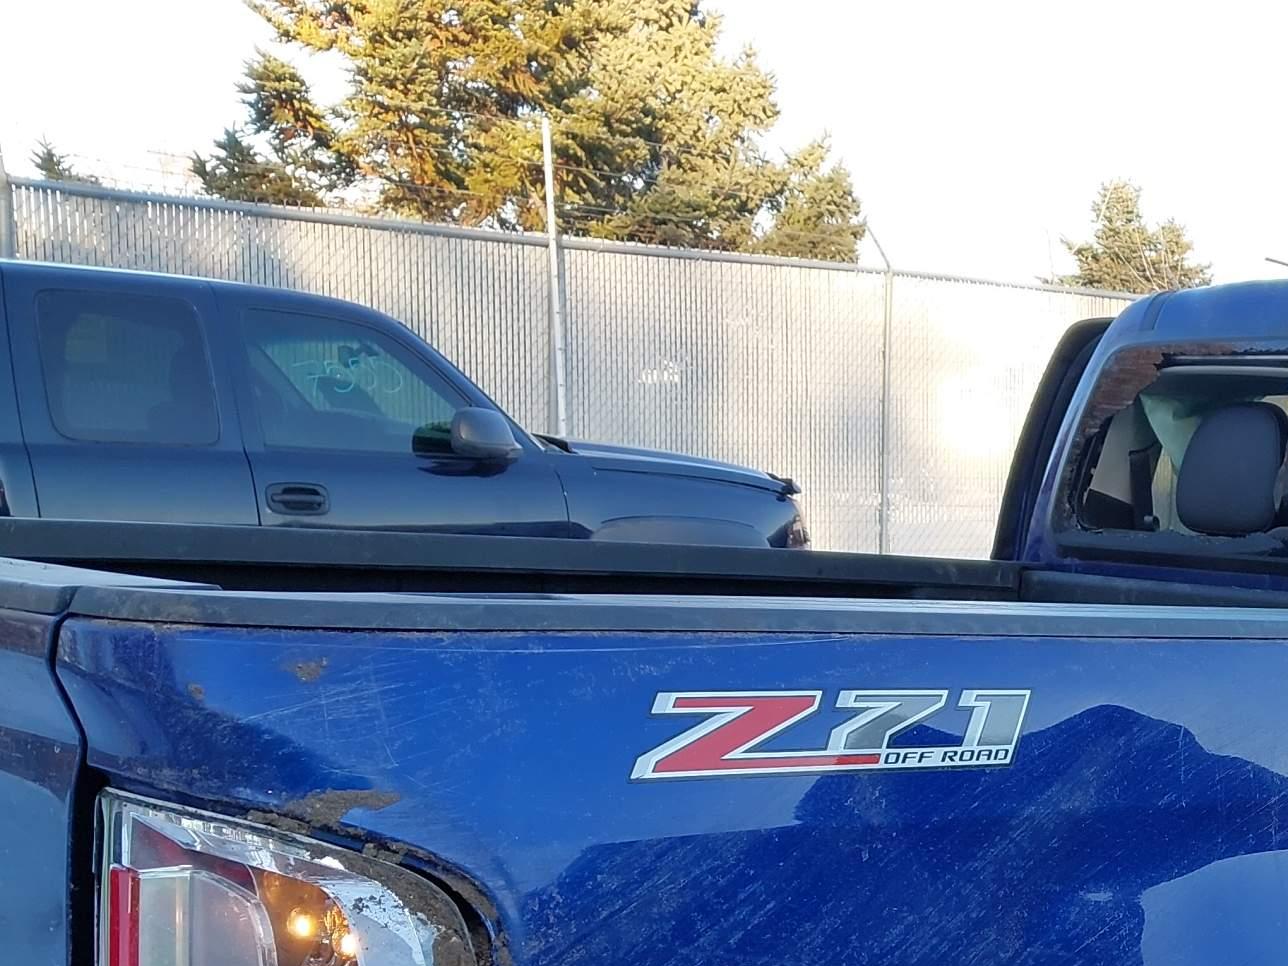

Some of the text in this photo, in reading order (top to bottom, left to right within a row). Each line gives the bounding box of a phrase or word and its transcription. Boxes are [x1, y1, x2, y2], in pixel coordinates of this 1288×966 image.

[629, 690, 1031, 780] Z71
[884, 748, 1011, 767] OFF ROAD
